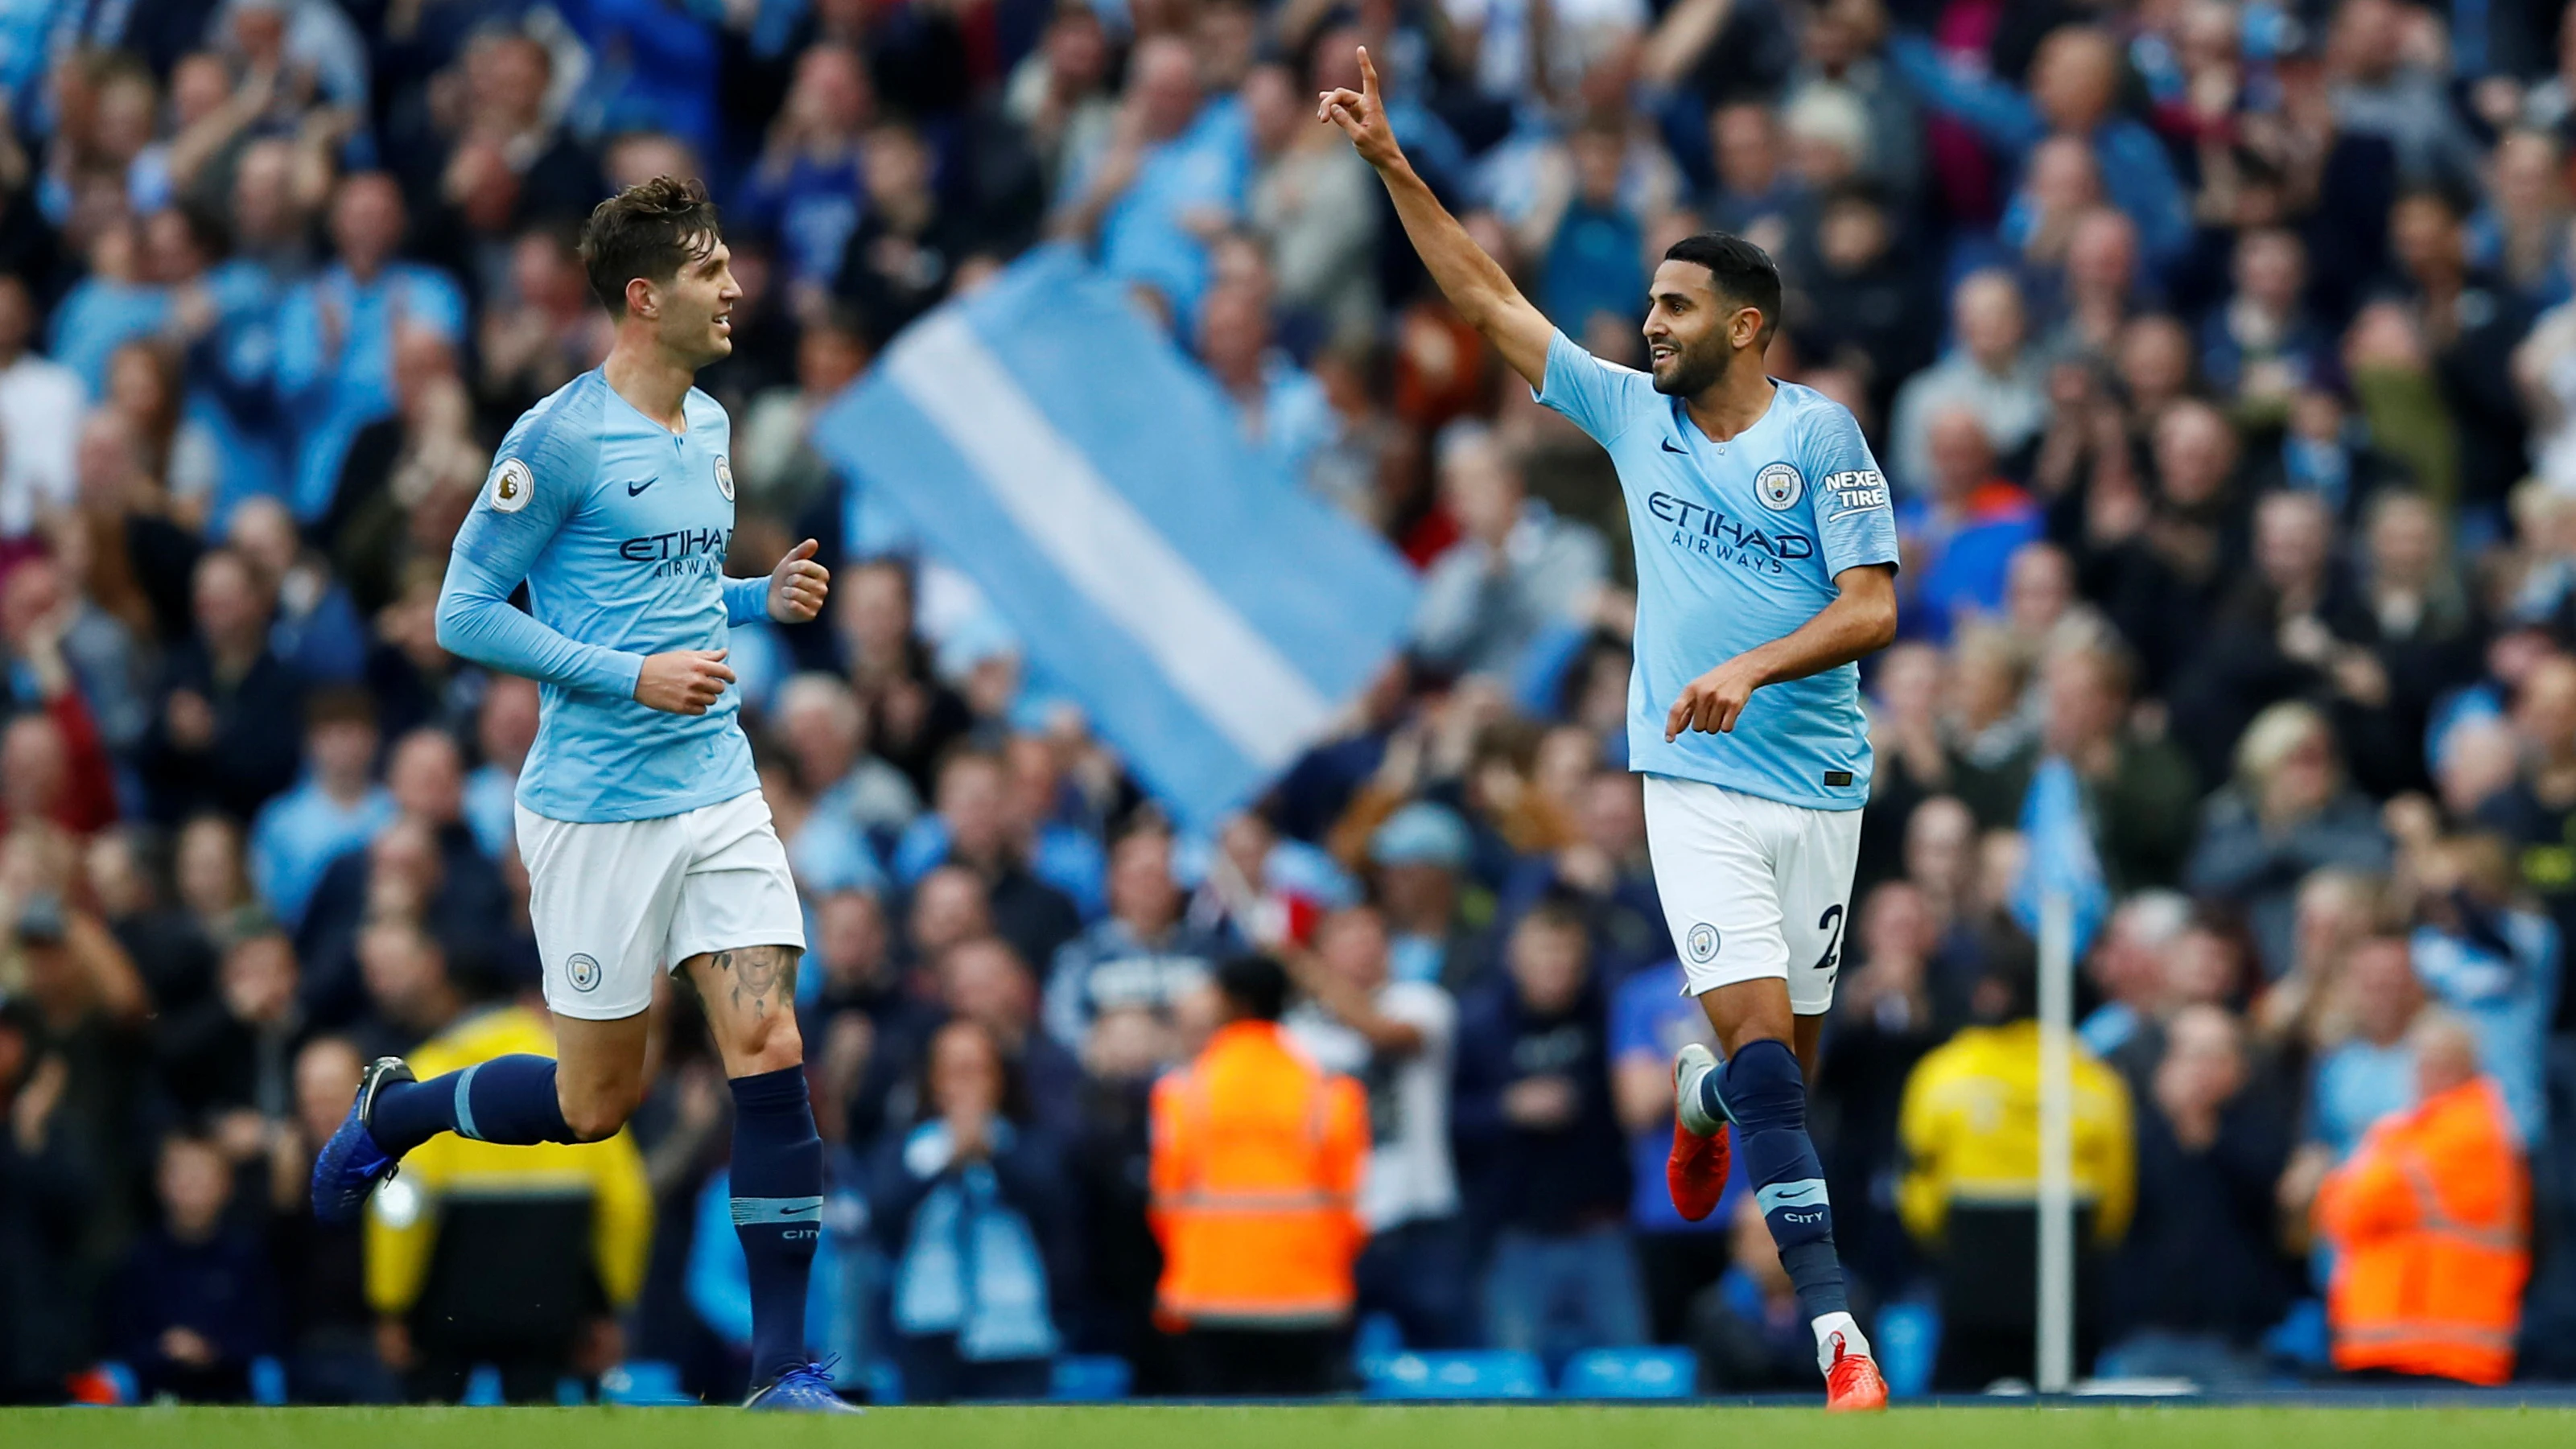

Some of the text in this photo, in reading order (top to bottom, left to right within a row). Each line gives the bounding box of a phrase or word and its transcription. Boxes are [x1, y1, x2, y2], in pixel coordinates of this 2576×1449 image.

[1759, 466, 1798, 480] MANCHESTER
[1837, 488, 1884, 507] TIRE
[1649, 492, 1813, 559] ETIHAD
[1671, 532, 1783, 573] AIRWAYS
[1784, 1212, 1823, 1223] CITY
